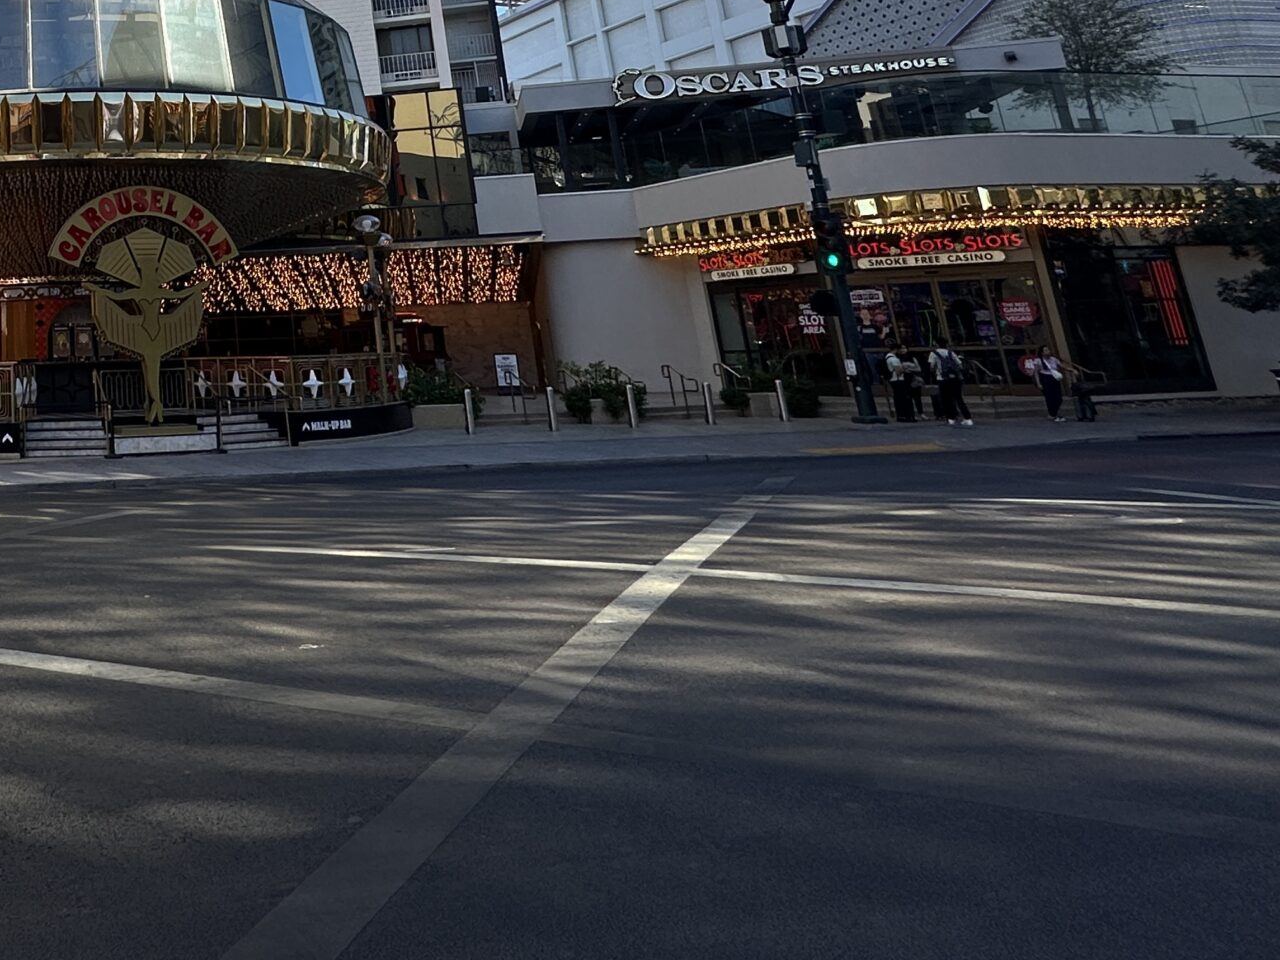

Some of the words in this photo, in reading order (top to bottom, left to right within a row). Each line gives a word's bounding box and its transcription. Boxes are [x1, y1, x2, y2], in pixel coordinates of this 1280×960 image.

[829, 58, 951, 76] STEAKHOUSE
[58, 188, 178, 262] CAROUSEL
[184, 203, 233, 263] BAR
[849, 242, 890, 257] LOTS
[900, 238, 955, 256] SLOTS
[964, 234, 1023, 251] SLOTS
[699, 256, 727, 271] SLOTS
[733, 252, 765, 266] SLOTS
[868, 257, 908, 267] SMOKE
[914, 255, 940, 264] FREE
[947, 252, 994, 263] CASINO
[716, 270, 739, 278] SMOKE
[760, 265, 788, 274] CASINO
[798, 315, 825, 326] SLOT
[803, 326, 826, 334] AREA
